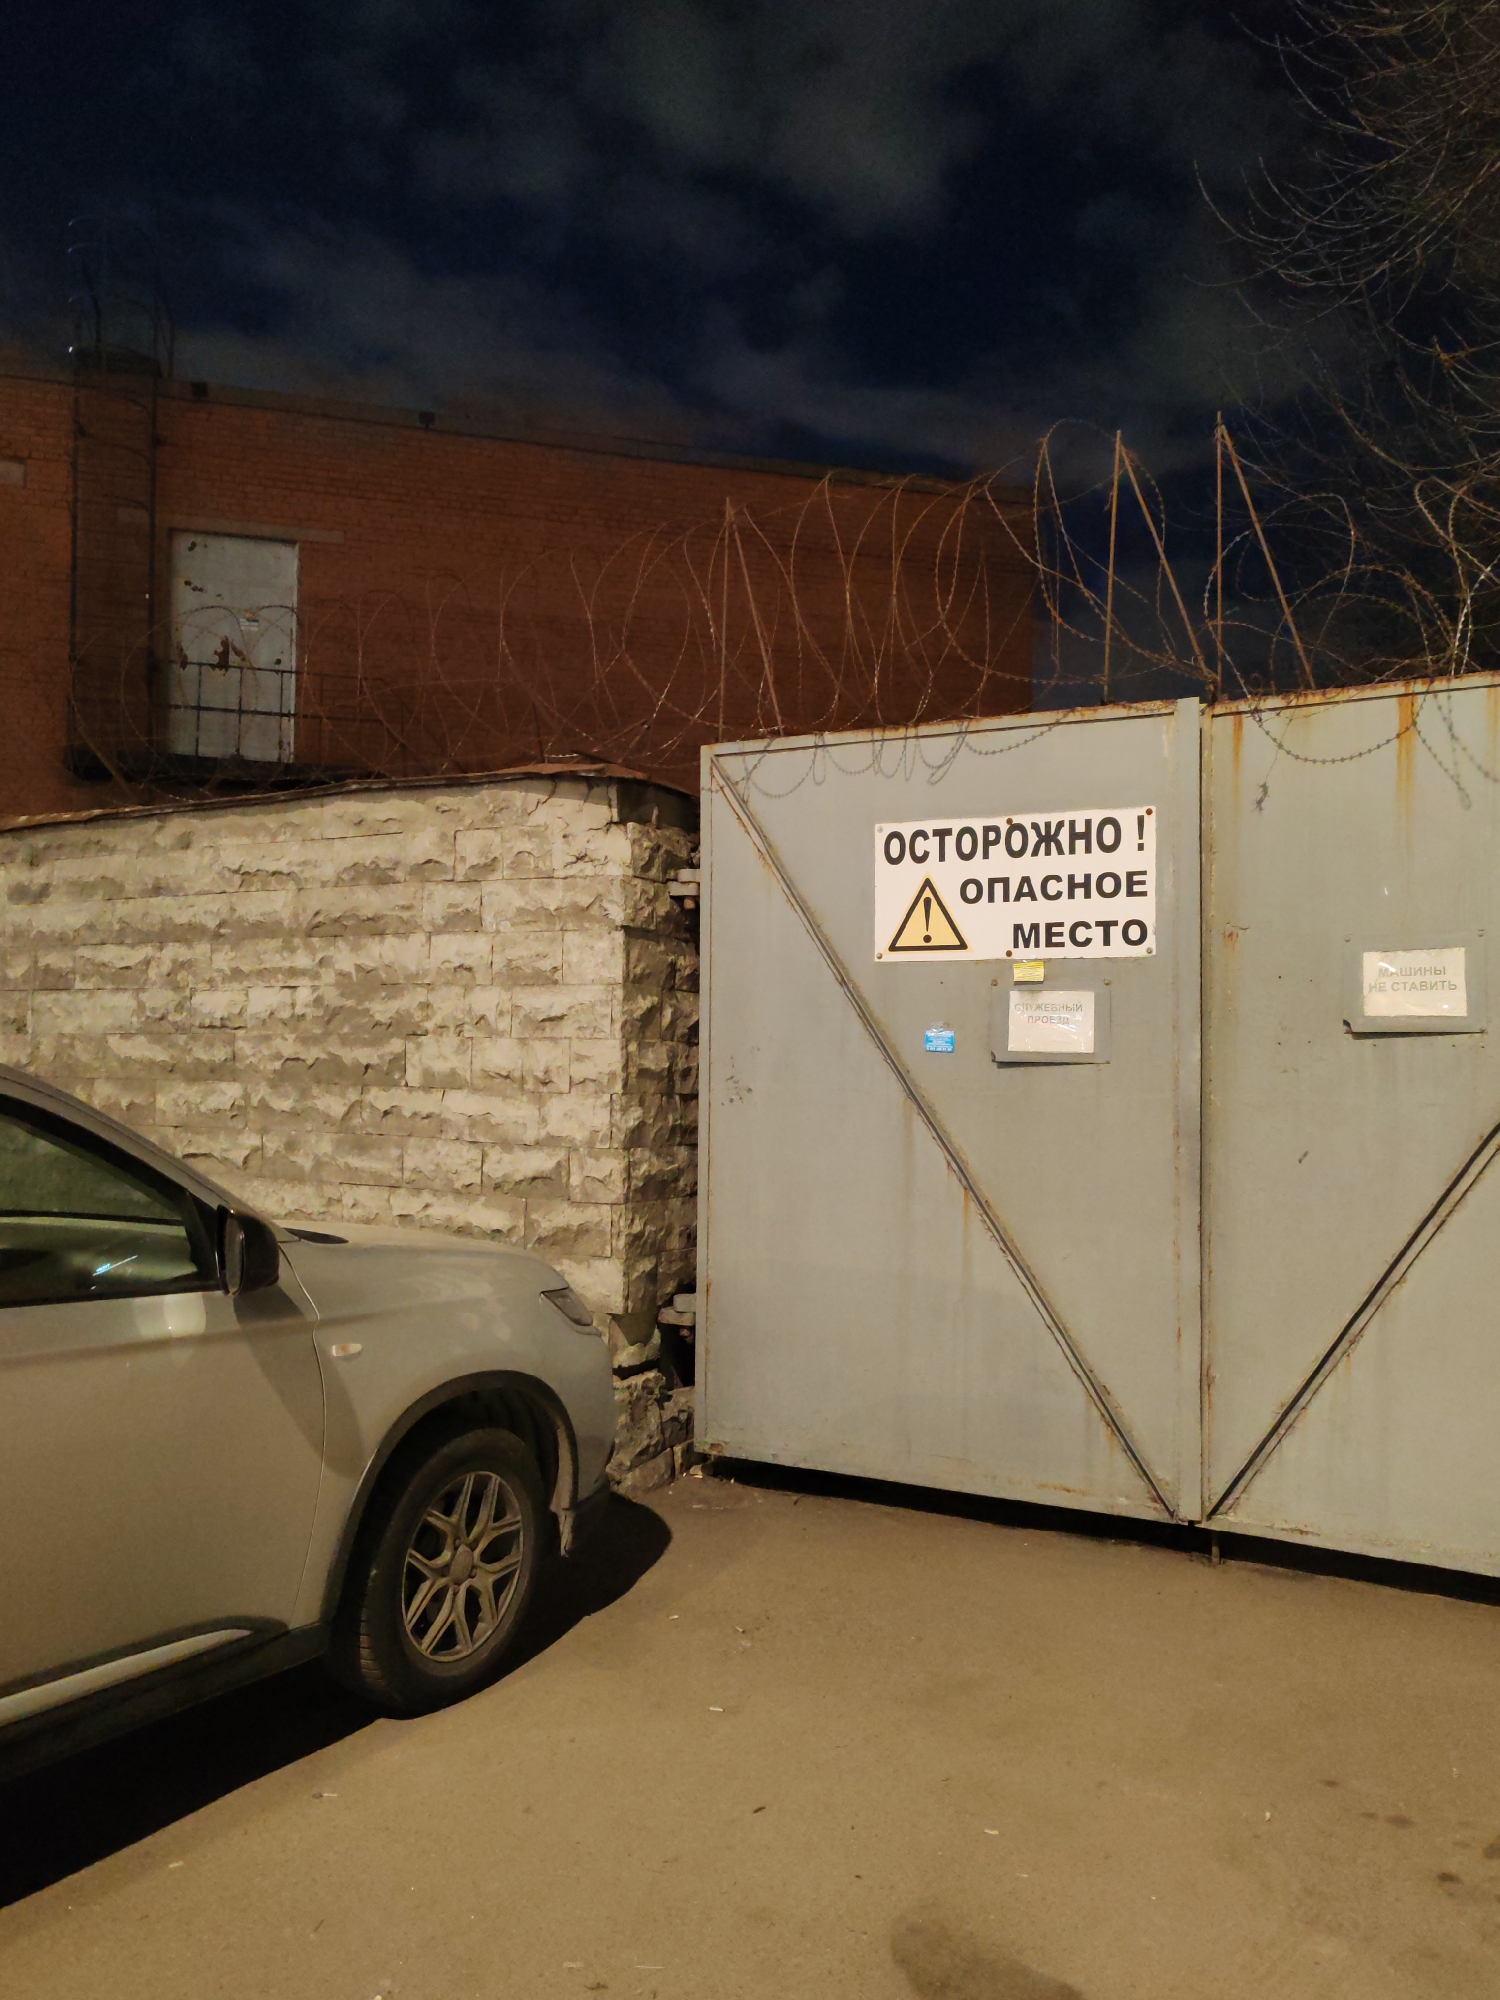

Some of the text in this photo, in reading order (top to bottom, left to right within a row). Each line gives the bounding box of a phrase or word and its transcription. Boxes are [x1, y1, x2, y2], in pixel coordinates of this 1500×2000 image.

[884, 816, 1122, 865] ОСТОРОЖНО
[959, 870, 1148, 904] ОПАСНОЕ
[1013, 919, 1148, 948] МЕСТО
[1368, 981, 1458, 993] НЕ СТАВИТЬ
